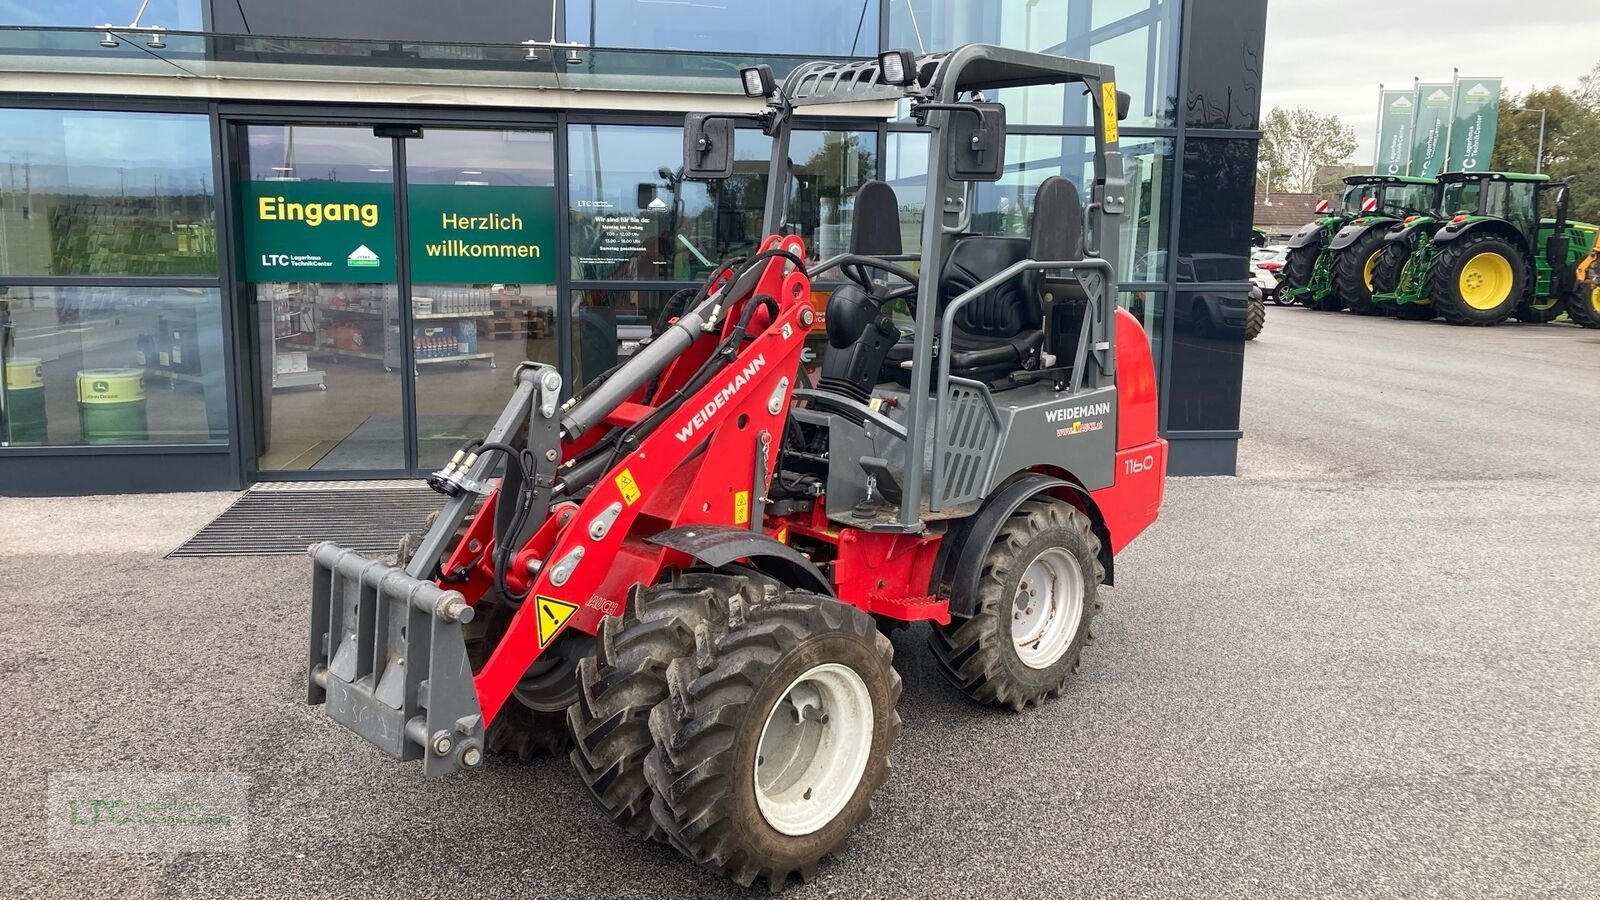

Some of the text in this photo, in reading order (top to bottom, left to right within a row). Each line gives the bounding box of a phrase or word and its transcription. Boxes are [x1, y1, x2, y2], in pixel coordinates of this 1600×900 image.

[1464, 125, 1475, 157] Lagerhaus
[258, 196, 379, 227] Eingang
[442, 212, 523, 230] Herzlich
[425, 239, 540, 257] willkommen
[262, 254, 289, 267] LTC
[674, 352, 767, 443] WEIDEMANN
[1045, 402, 1110, 423] WEIDEMANN
[1124, 455, 1154, 475] 1160
